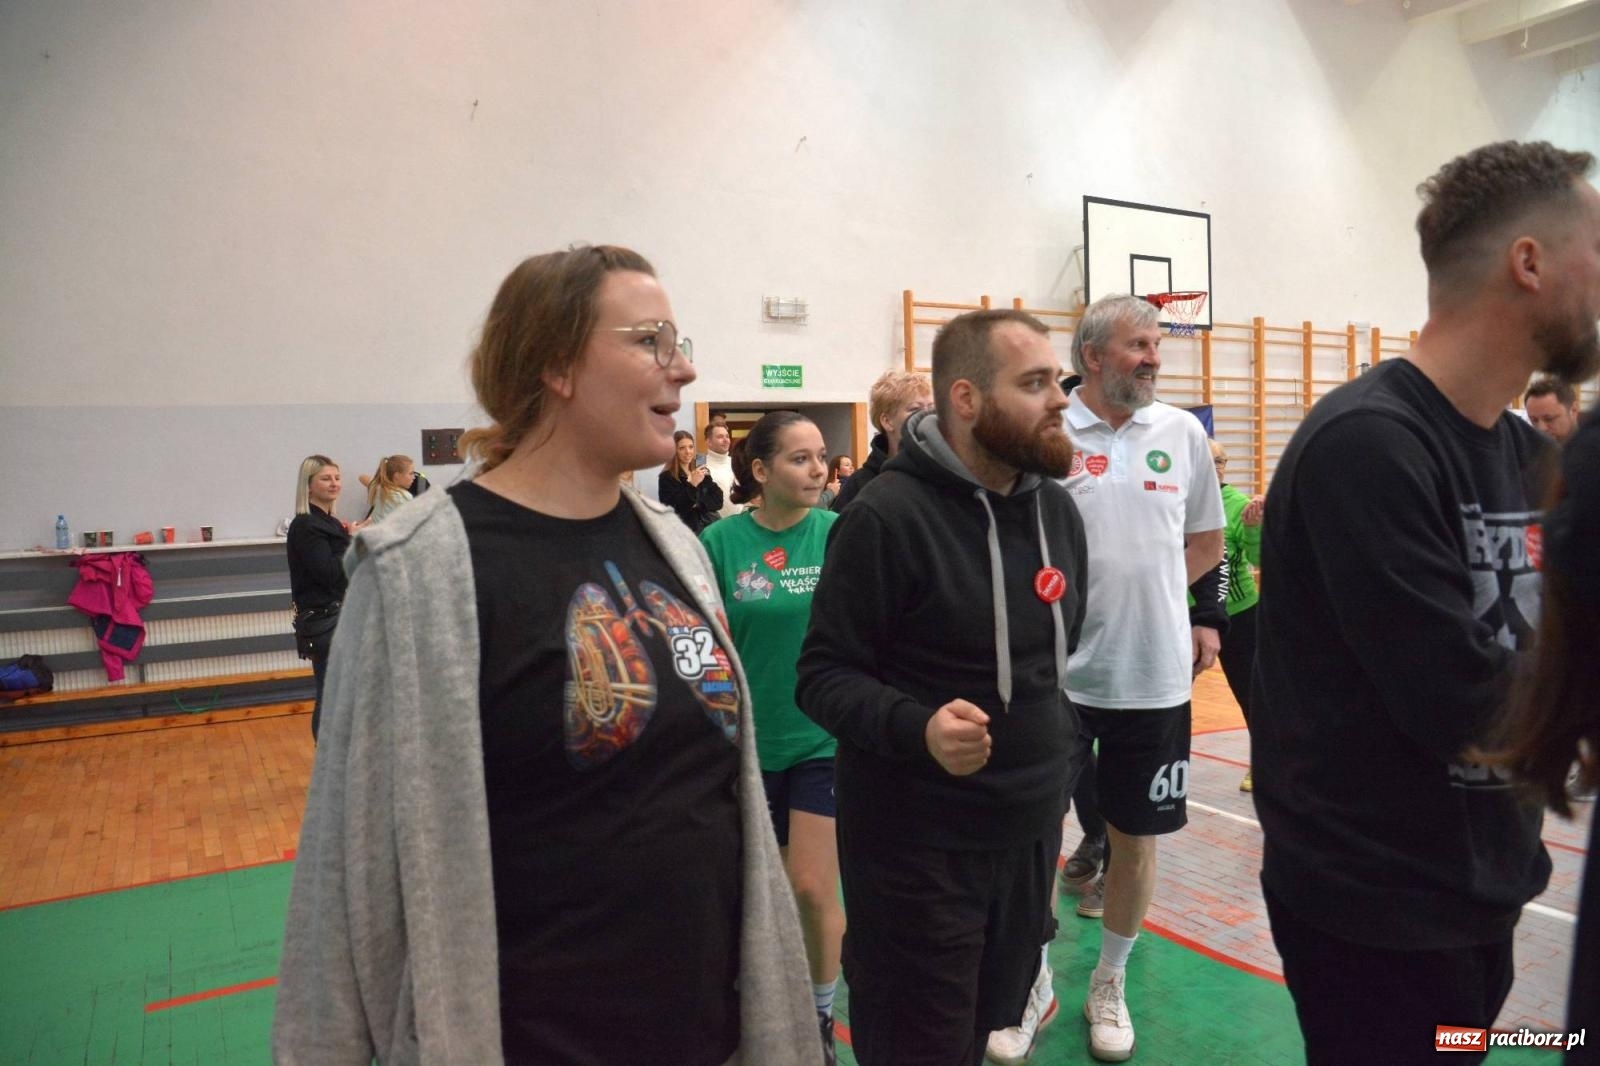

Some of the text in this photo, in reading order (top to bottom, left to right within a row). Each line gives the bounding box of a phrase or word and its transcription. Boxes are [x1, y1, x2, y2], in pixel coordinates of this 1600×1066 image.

[765, 367, 800, 377] WYJŚCIE
[673, 628, 719, 677] 32
[1148, 759, 1189, 802] 60
